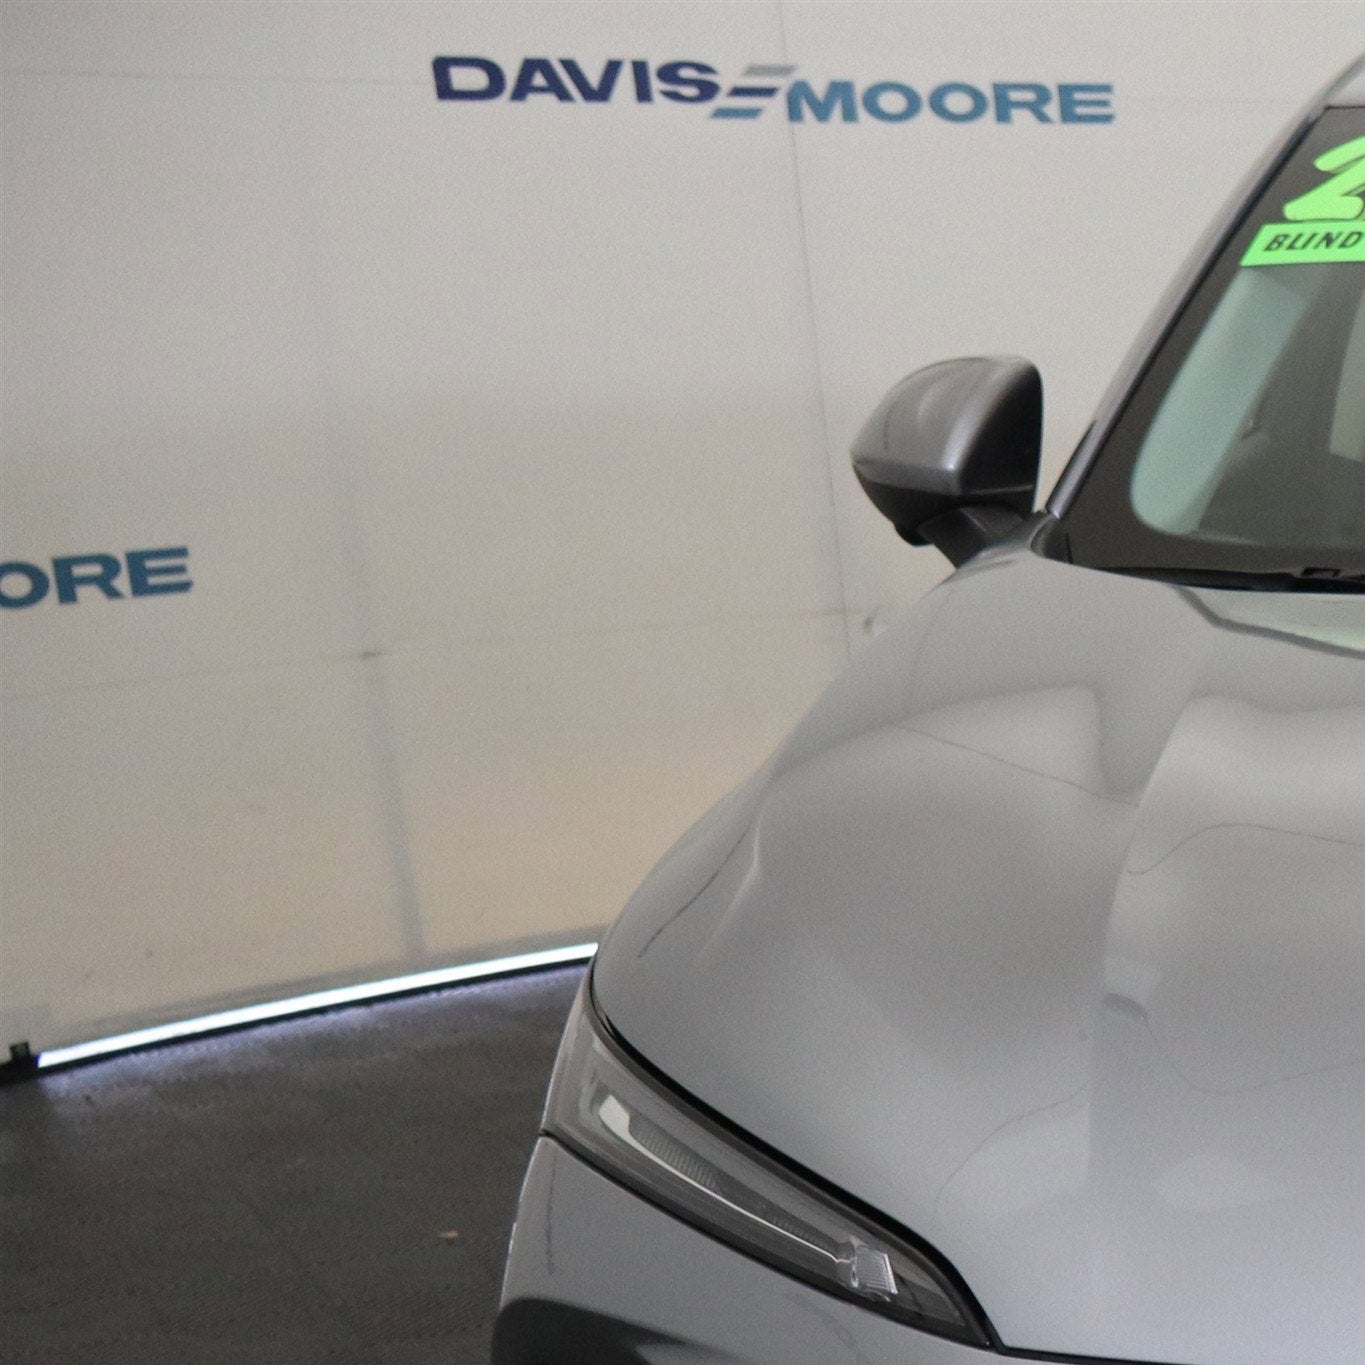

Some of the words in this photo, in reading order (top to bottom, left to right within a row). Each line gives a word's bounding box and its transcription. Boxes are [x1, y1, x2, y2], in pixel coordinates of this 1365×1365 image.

[432, 56, 720, 103] DAVIS
[787, 80, 1117, 124] MOORE
[1263, 229, 1362, 252] BLIND
